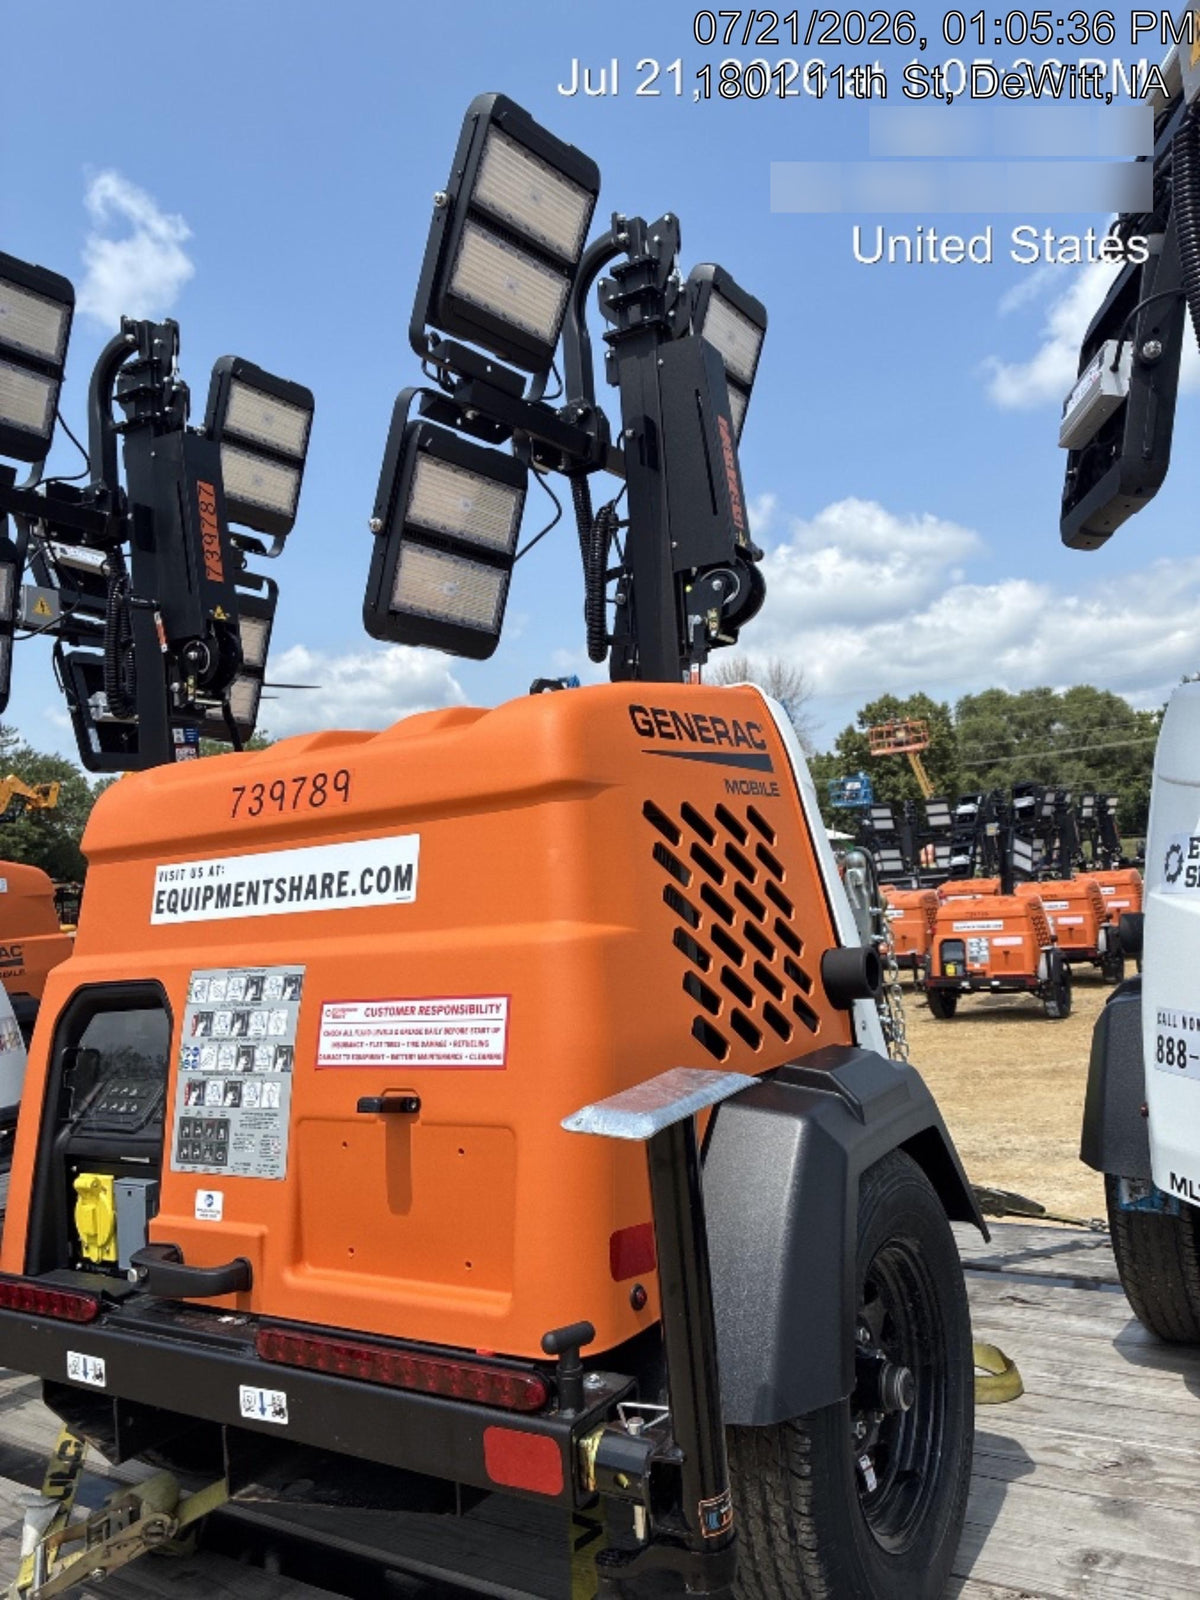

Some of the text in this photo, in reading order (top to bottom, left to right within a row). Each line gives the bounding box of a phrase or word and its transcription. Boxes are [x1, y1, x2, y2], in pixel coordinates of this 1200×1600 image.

[628, 703, 767, 751] GENERAC
[231, 769, 351, 819] 739789
[723, 778, 781, 798] MOBILE
[155, 863, 414, 915] EQUIPMENTSHARE.COM
[158, 864, 225, 883] VISIT US AT:
[363, 1005, 418, 1018] CUSTOMER
[418, 1003, 502, 1017] RESPONSIBILITY
[1157, 1012, 1178, 1028] CALL
[1157, 1034, 1199, 1069] 888-
[1170, 1171, 1200, 1202] ML
